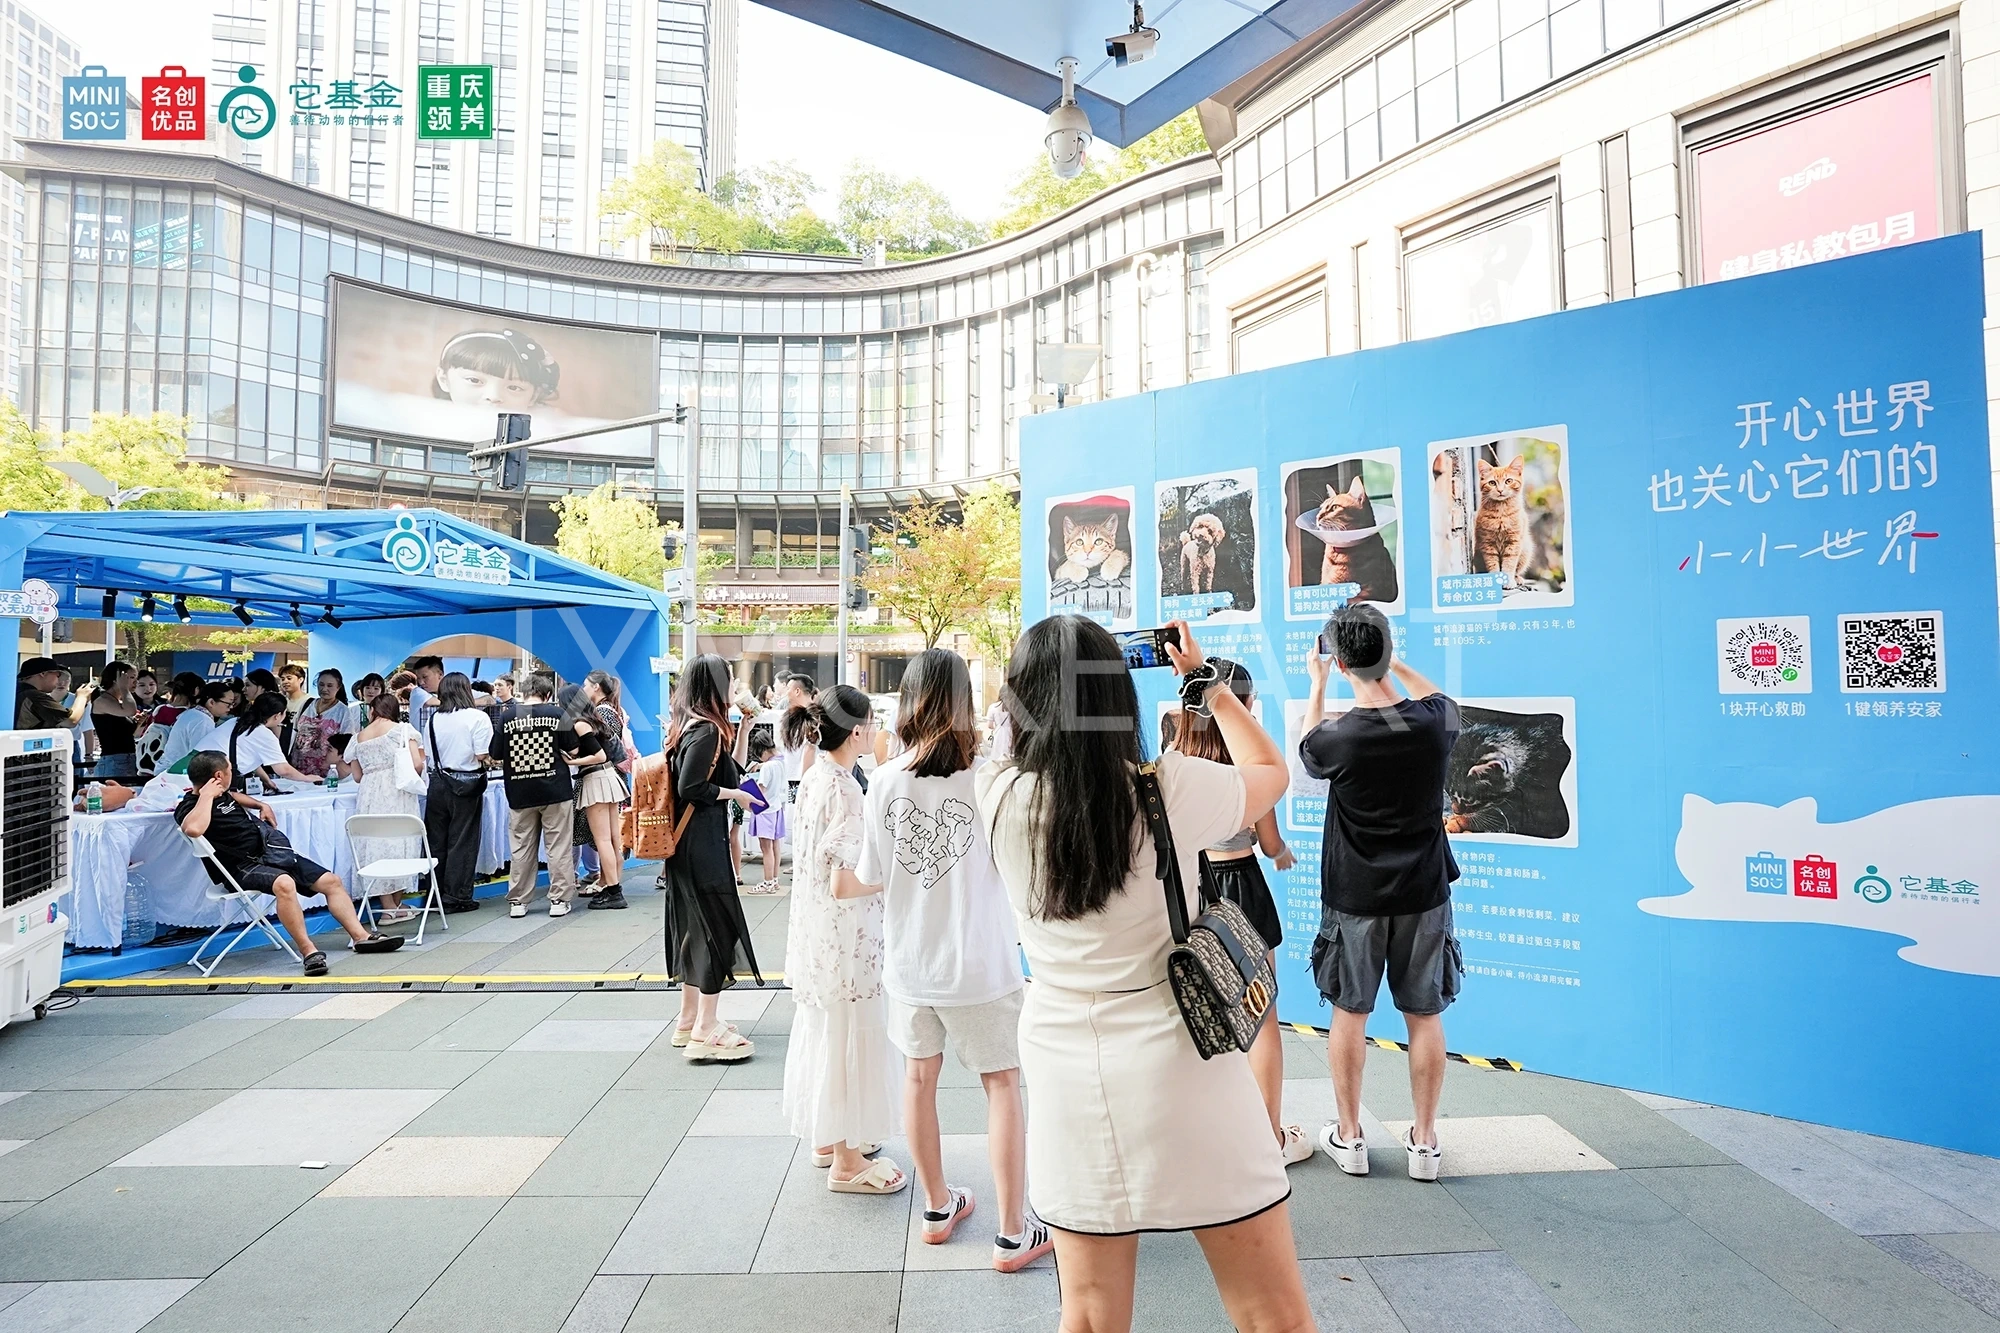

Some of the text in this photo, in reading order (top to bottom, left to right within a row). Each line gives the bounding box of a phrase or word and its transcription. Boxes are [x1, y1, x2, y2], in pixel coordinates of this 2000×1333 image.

[1718, 210, 1916, 281] 健身私教包月
[1734, 378, 1936, 450] 开心世界
[1647, 440, 1939, 512] 也关心它们的
[436, 543, 508, 571] 它基金
[1441, 576, 1494, 590] 城市流浪猫
[1442, 589, 1498, 604] 寿命仅 3 年
[1542, 620, 1550, 629] 3
[1452, 636, 1475, 646] 1095
[1753, 647, 1775, 656] MINI
[1719, 701, 1807, 718] 1块开心救助
[1845, 701, 1943, 718] 1键领养安家
[1750, 862, 1783, 876] MINI
[1800, 865, 1831, 880] 名创
[1800, 879, 1832, 894] 优品
[1899, 874, 1980, 896] 它基金
